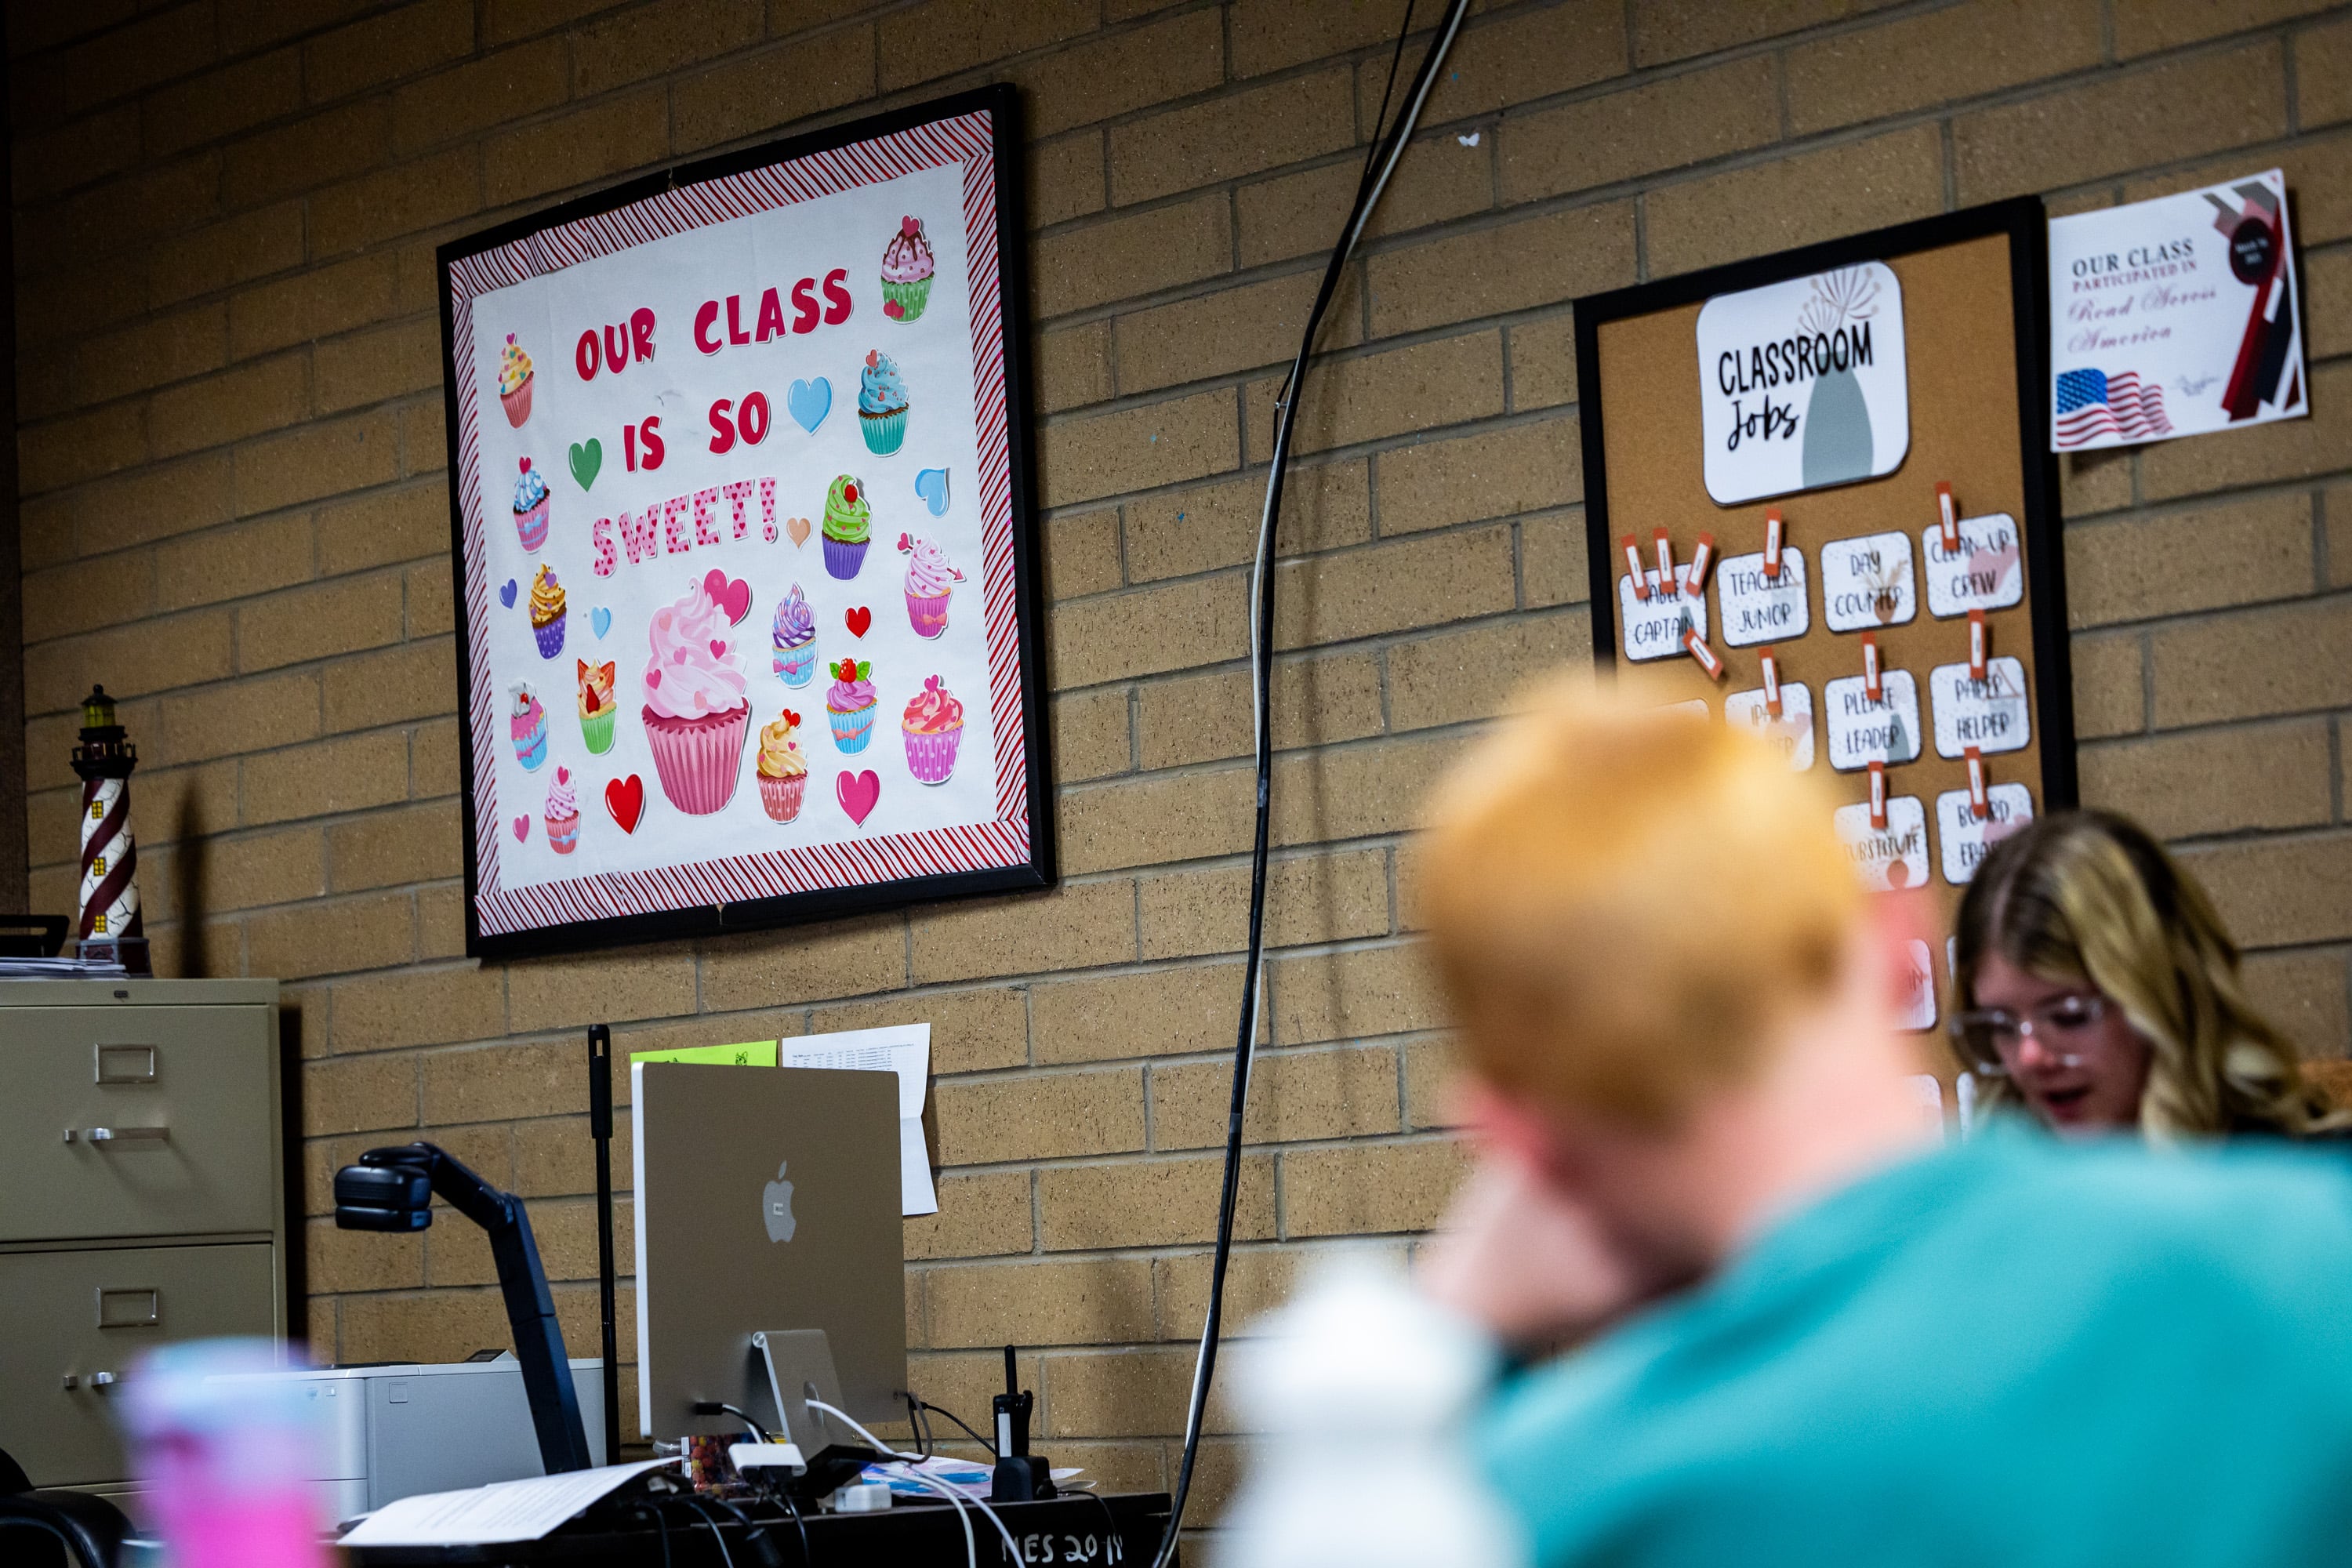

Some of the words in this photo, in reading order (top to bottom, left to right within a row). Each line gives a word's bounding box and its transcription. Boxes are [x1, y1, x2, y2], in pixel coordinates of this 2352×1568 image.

[2072, 253, 2119, 278] OUR
[2128, 238, 2194, 267] CLASS
[2072, 263, 2178, 293] PARTICIPATED
[575, 307, 657, 382] OUR
[694, 268, 853, 356] CLASS
[1719, 321, 1874, 396] CLASSROOM
[623, 416, 666, 473] IS
[708, 390, 770, 456] SO
[1727, 394, 1800, 452] Jobs
[593, 476, 778, 578] SWEET!
[1987, 528, 2009, 554] UP
[1850, 550, 1881, 576] DAY
[1951, 569, 1996, 598] CREW
[1738, 603, 1791, 633] JUNIOR
[1846, 724, 1900, 754] LEADER
[1956, 712, 2010, 741] HELPER
[1957, 800, 2010, 828] BORD
